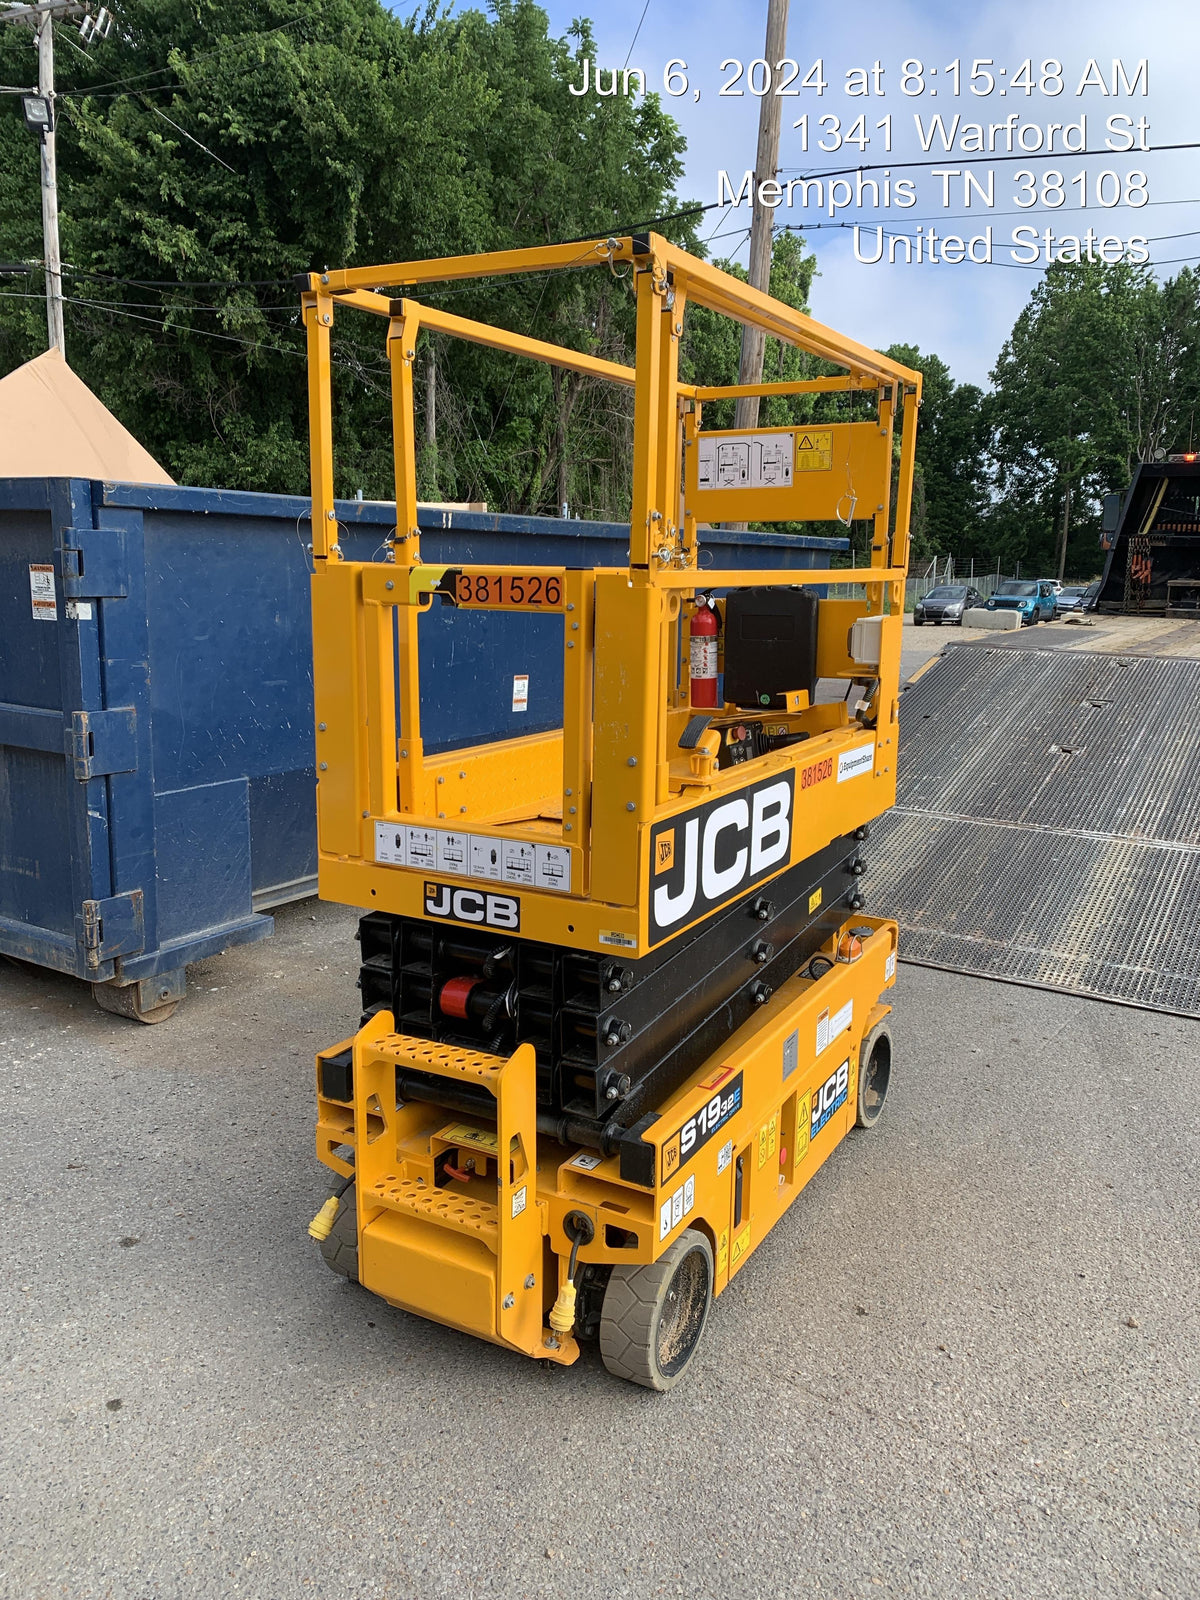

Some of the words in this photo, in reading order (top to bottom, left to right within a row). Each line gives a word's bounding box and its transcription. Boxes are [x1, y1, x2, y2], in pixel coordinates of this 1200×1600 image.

[458, 575, 562, 604] 381526
[801, 757, 833, 790] 381526
[654, 780, 791, 928] JCB
[659, 841, 672, 861] JCB
[426, 887, 519, 928] JCB
[812, 1061, 849, 1124] JCB
[811, 1087, 848, 1140] ELECTRIC
[666, 1147, 677, 1167] JCB
